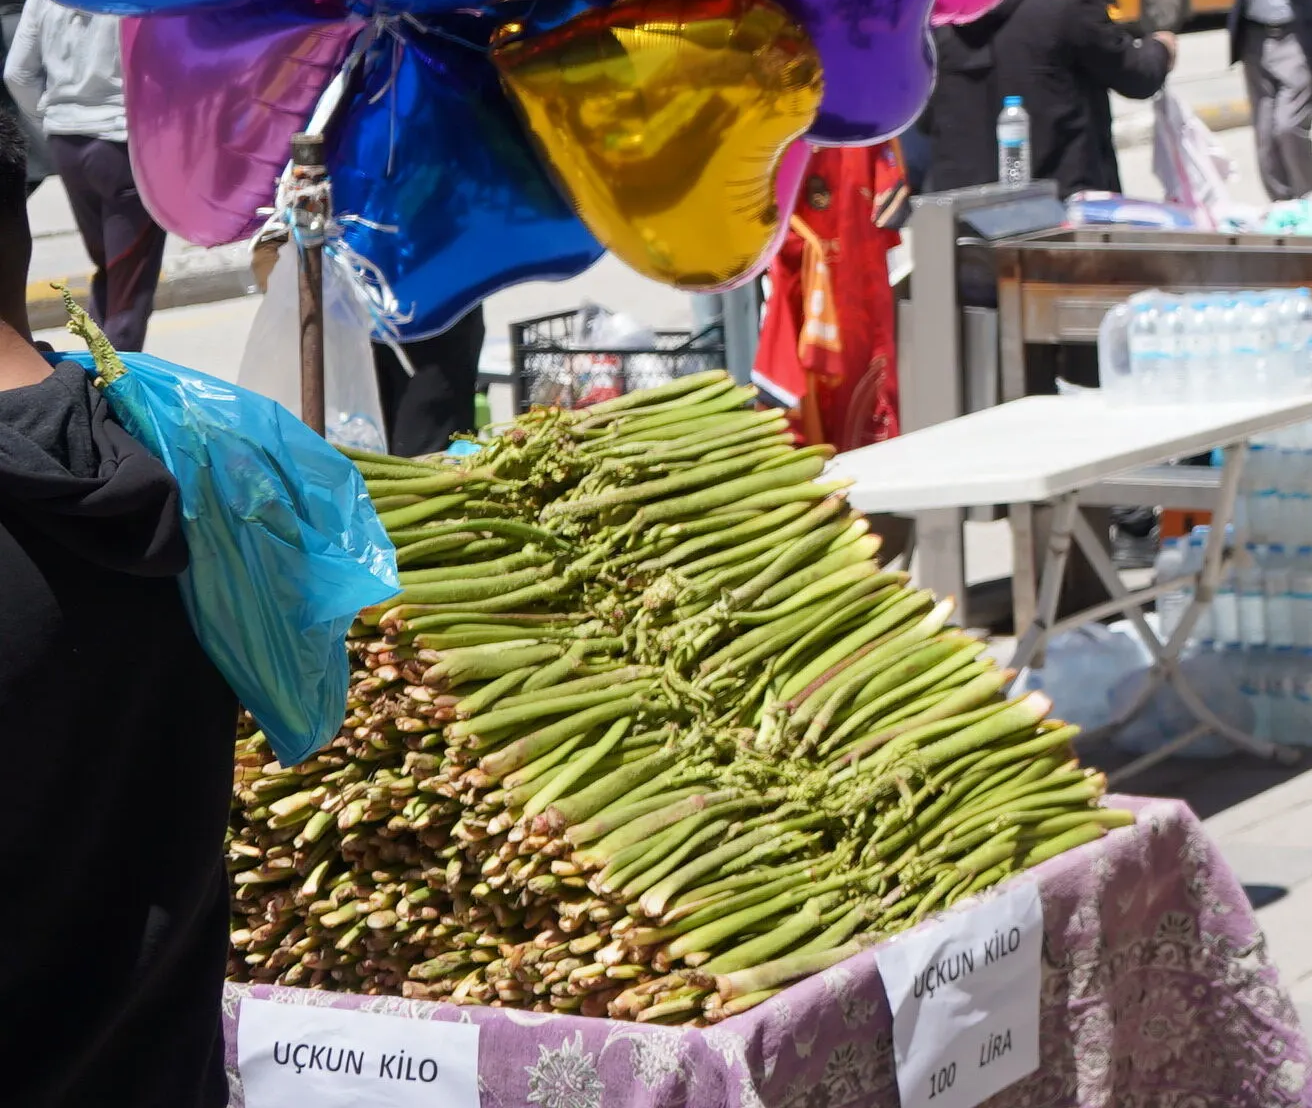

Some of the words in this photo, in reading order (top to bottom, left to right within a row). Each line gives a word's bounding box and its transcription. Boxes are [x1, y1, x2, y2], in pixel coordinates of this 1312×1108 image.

[913, 948, 974, 999] UÇKUN
[983, 927, 1021, 967] KİLO
[273, 1041, 365, 1075] UÇKUN
[379, 1049, 438, 1083] KİLO
[928, 1061, 957, 1100] 100
[978, 1028, 1013, 1069] LİRA
